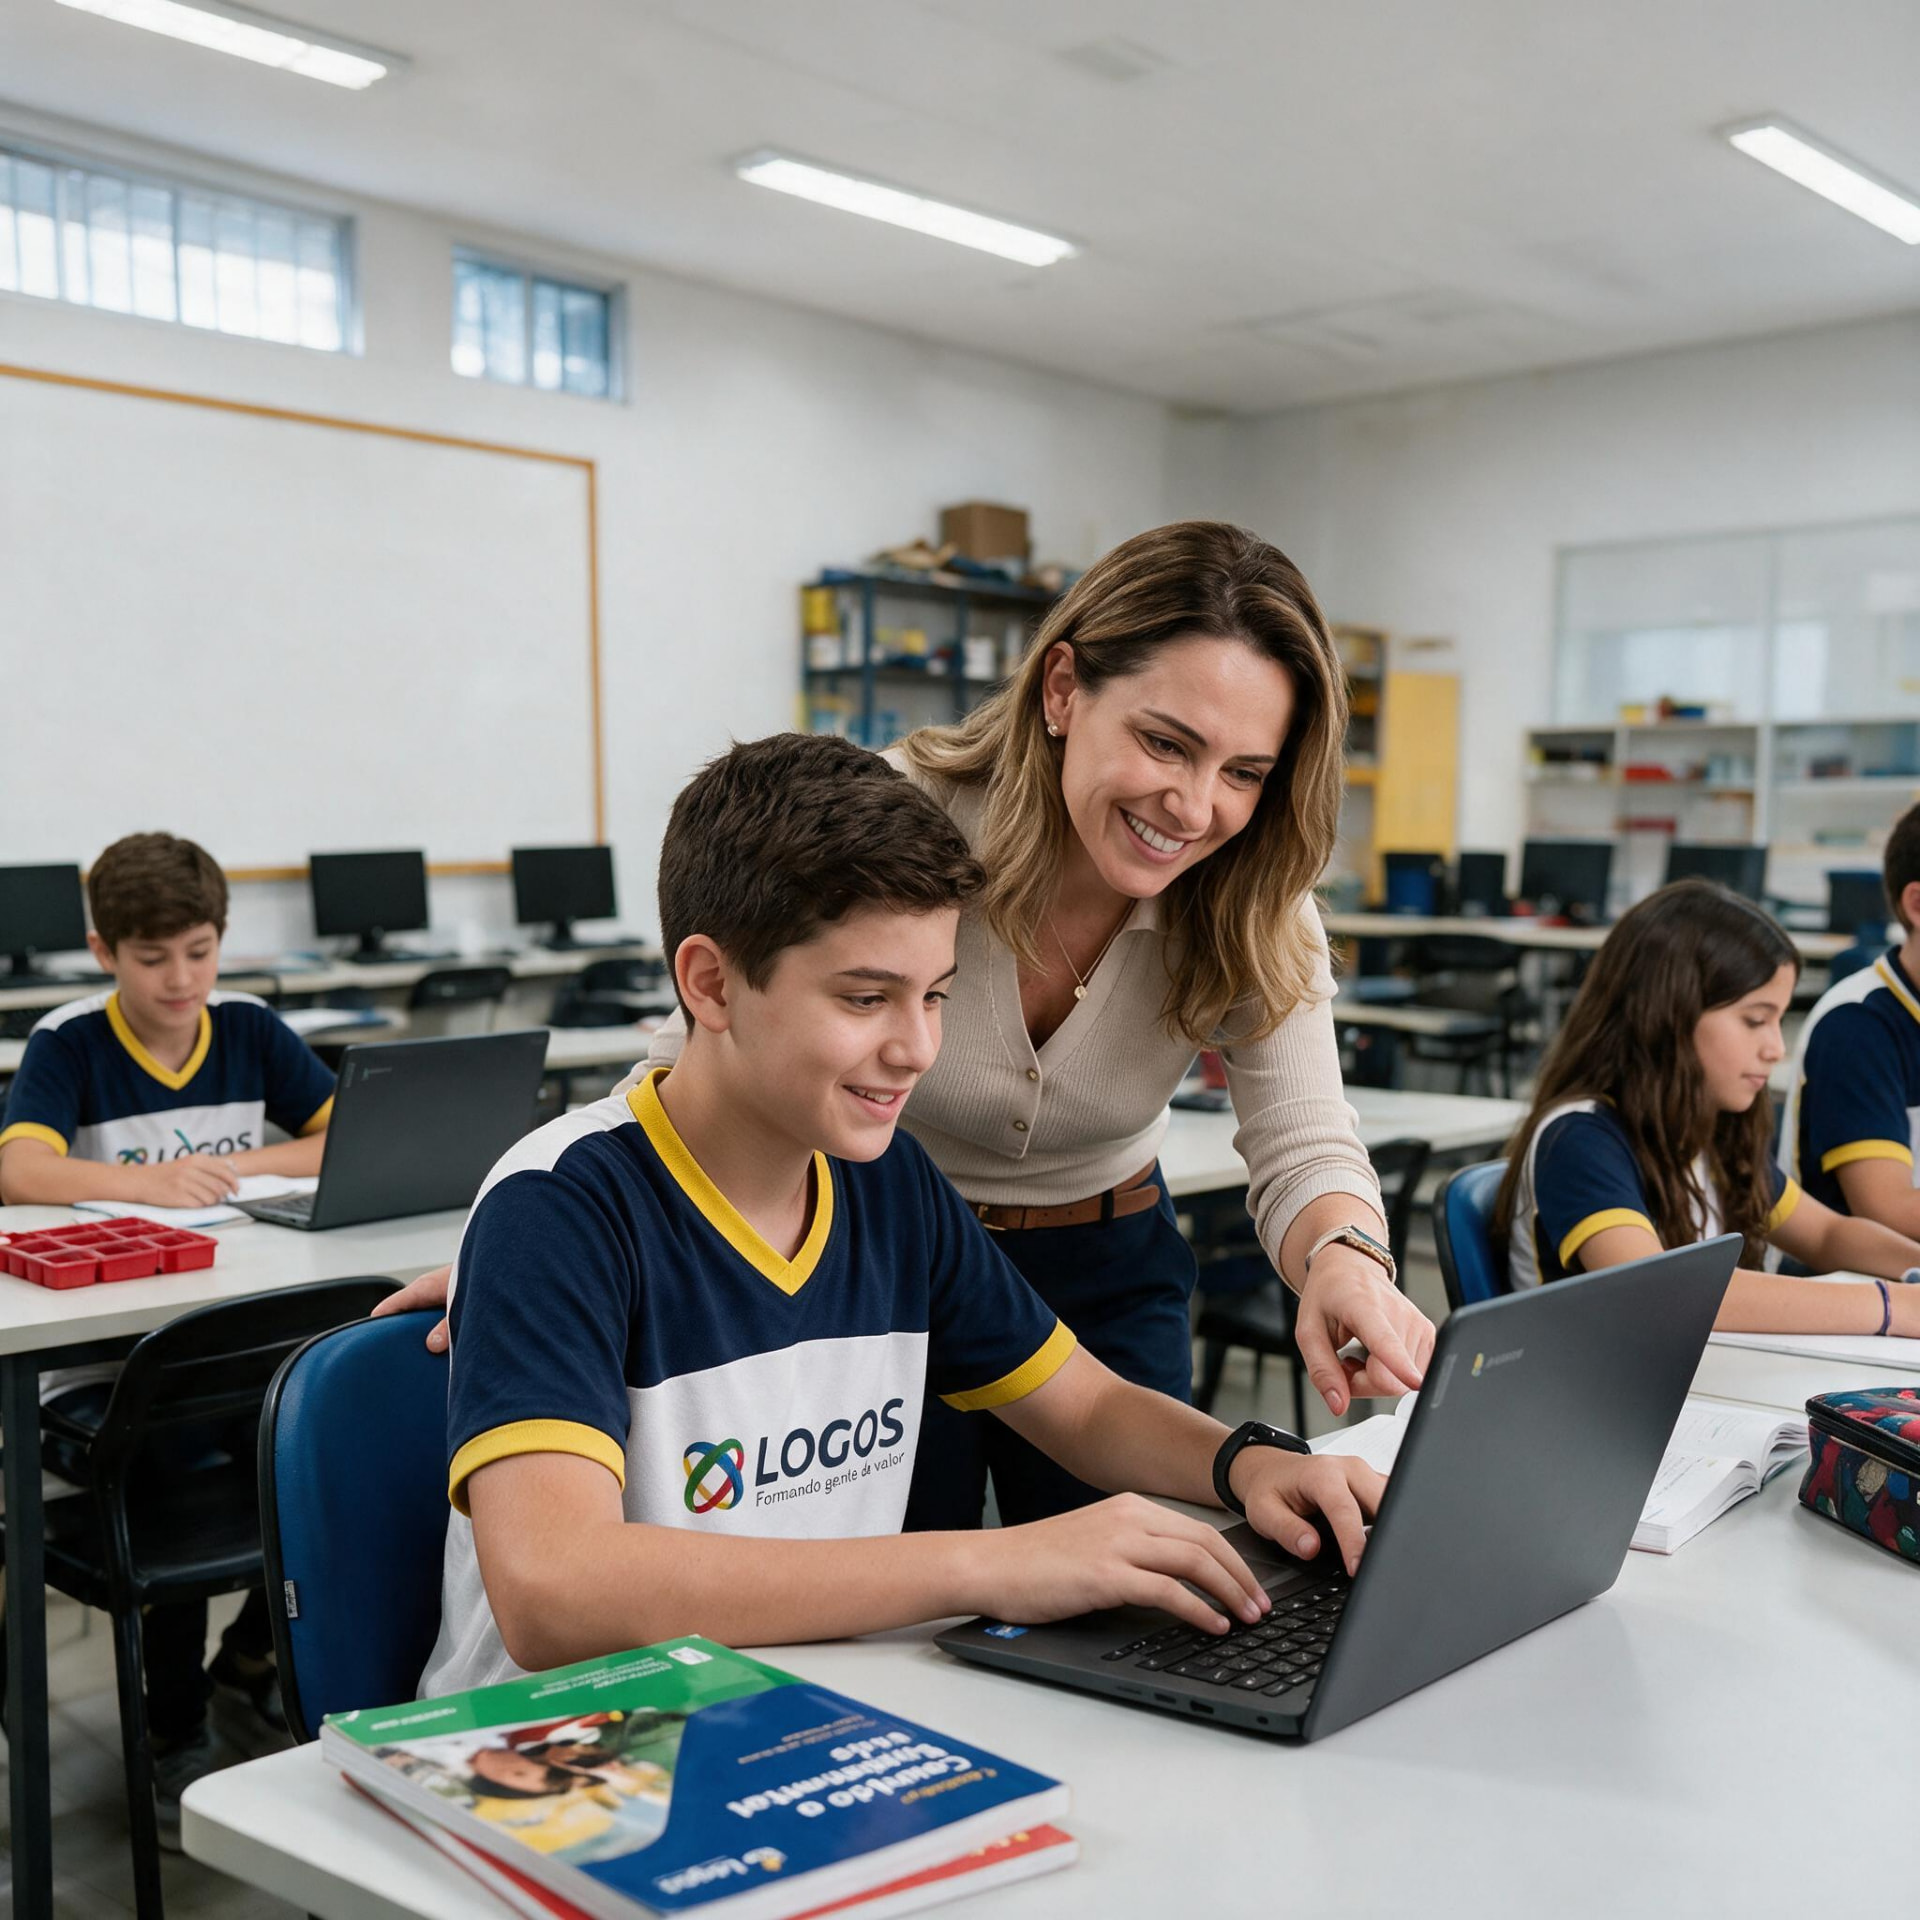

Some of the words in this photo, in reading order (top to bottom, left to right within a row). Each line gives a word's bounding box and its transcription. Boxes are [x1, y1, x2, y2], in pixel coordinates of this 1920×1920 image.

[755, 1398, 904, 1487] LOGOS
[756, 1479, 821, 1507] Formando
[824, 1471, 858, 1494] gente
[873, 1452, 905, 1473] valor
